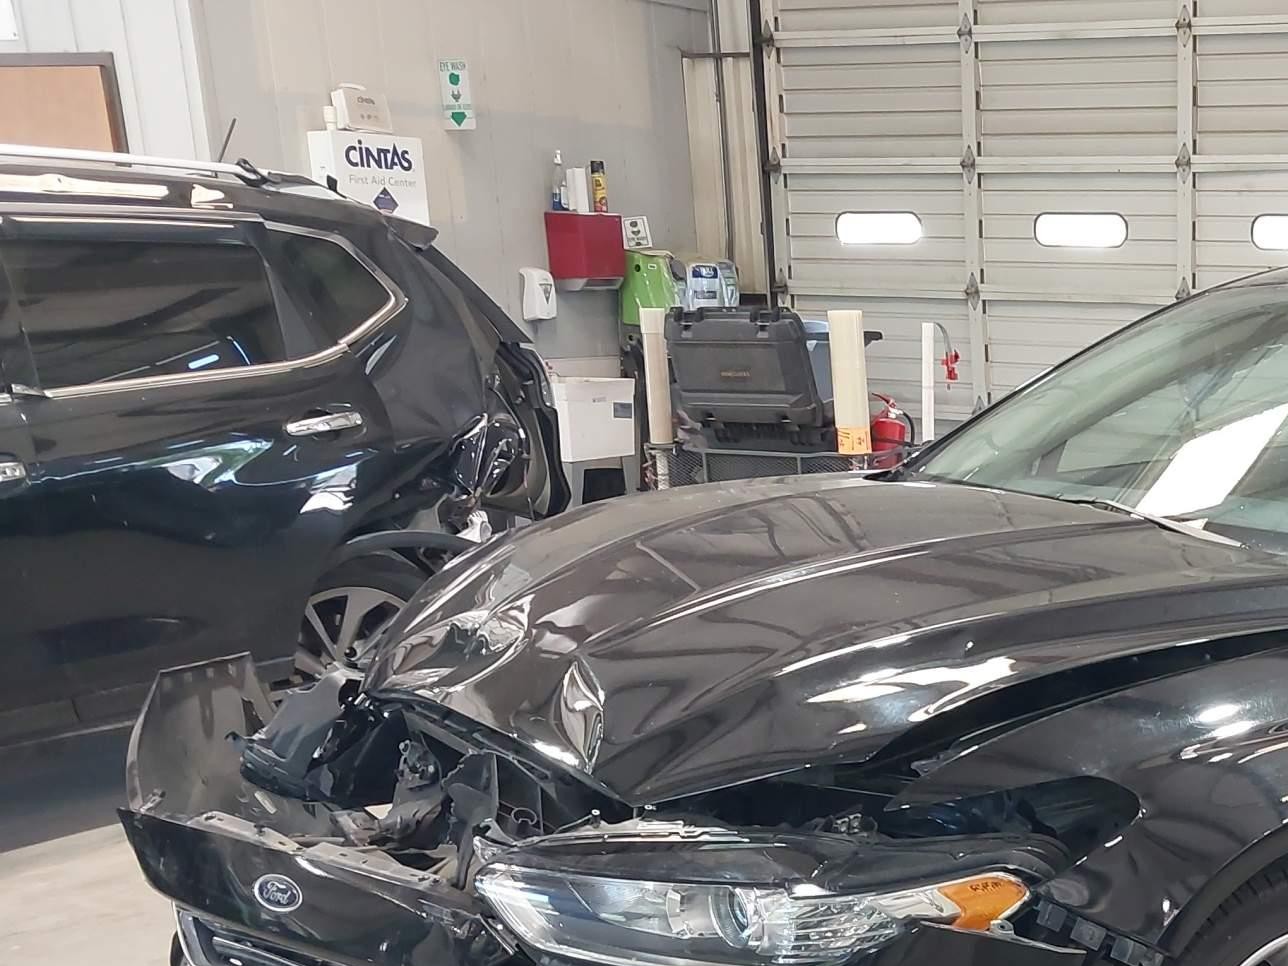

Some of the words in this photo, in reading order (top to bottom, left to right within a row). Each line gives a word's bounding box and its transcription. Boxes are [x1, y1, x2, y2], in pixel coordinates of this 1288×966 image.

[349, 174, 368, 185] First
[371, 175, 386, 186] Aid
[388, 176, 416, 188] Center
[263, 880, 291, 904] Ford
